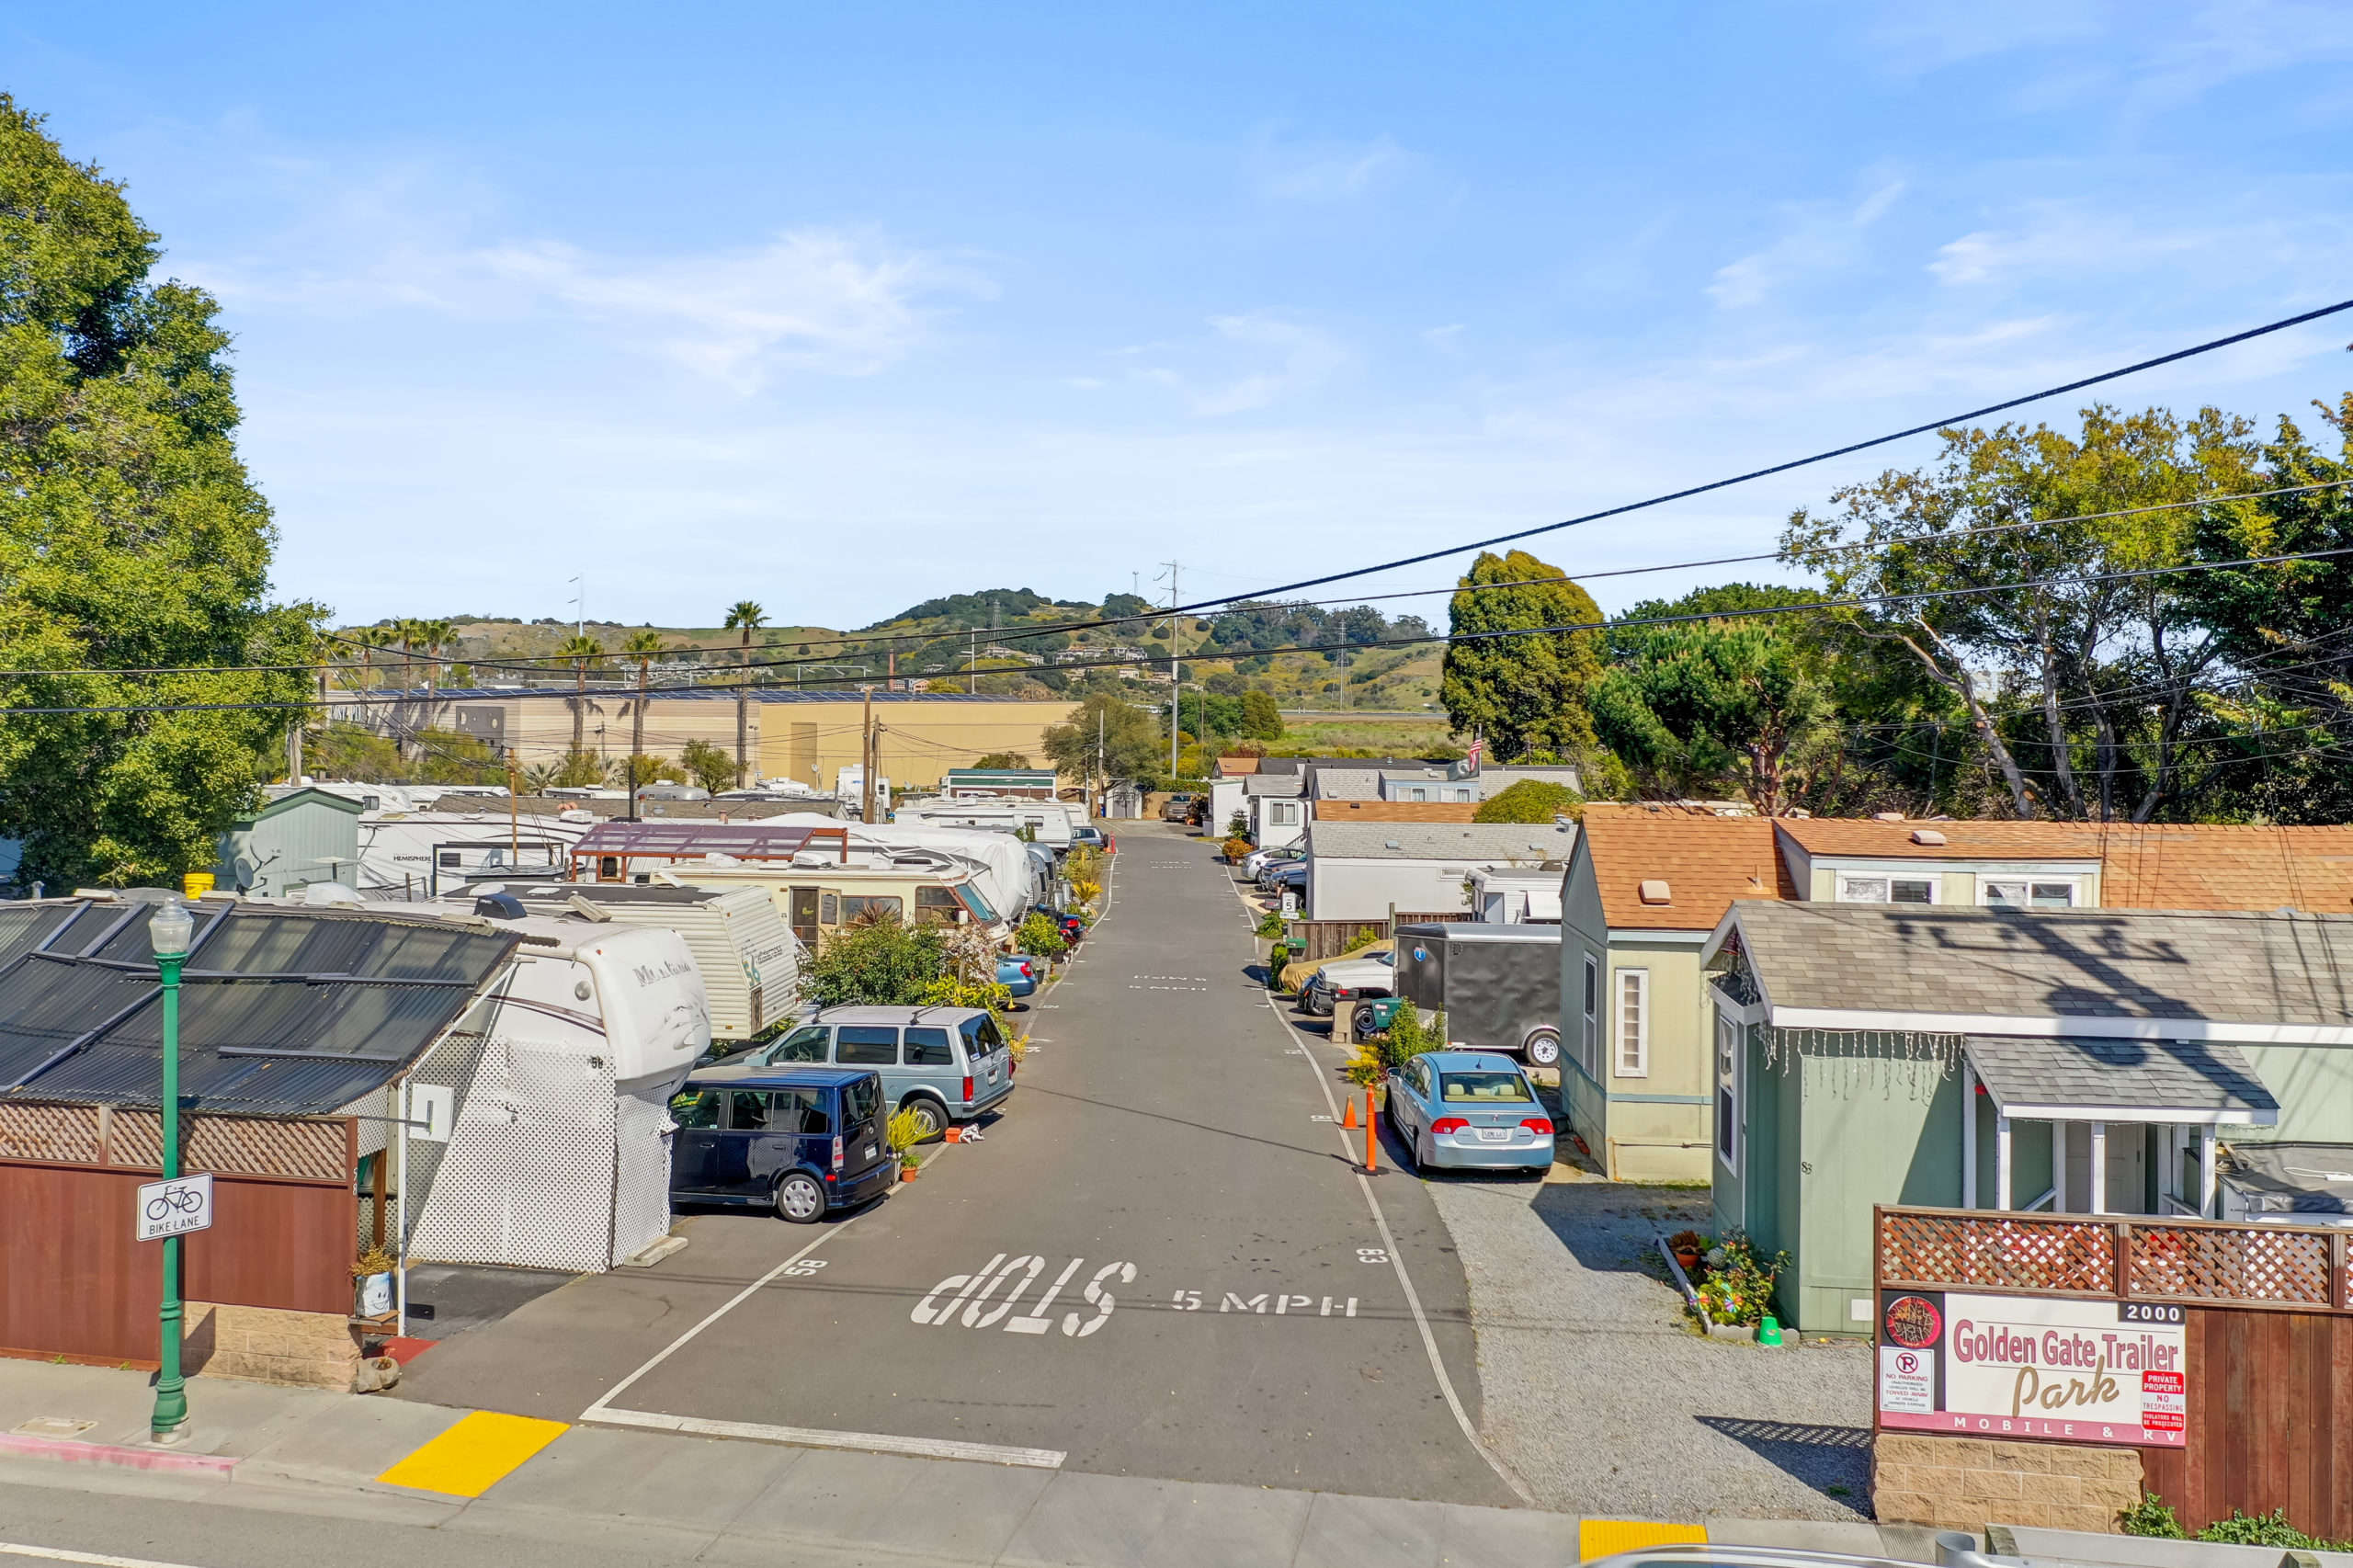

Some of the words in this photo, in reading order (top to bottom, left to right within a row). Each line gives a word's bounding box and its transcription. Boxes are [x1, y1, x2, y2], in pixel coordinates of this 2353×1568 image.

[1286, 902, 1292, 910] 5
[743, 954, 761, 987] 56
[591, 1056, 604, 1069] 58
[149, 1221, 172, 1235] BIKE
[173, 1215, 199, 1231] LANE
[784, 1259, 829, 1276] 58
[911, 1253, 1138, 1337] STOP
[1170, 1290, 1203, 1311] 5
[1219, 1292, 1358, 1317] MPH
[2126, 1304, 2180, 1322] 2000
[1953, 1319, 2037, 1363] Golden
[2042, 1330, 2096, 1368] Gate
[2101, 1334, 2178, 1370] Trailer
[2012, 1355, 2120, 1419] Park
[2143, 1382, 2182, 1392] PROPERTY
[2147, 1375, 2178, 1384] PRIVATE
[2156, 1394, 2169, 1403] NO
[2143, 1402, 2184, 1413] TRESPASSING
[1954, 1416, 2074, 1436] MOBILE
[2102, 1426, 2114, 1438] &
[2143, 1430, 2177, 1442] RV
[2152, 1420, 2183, 1428] PROSECUTED
